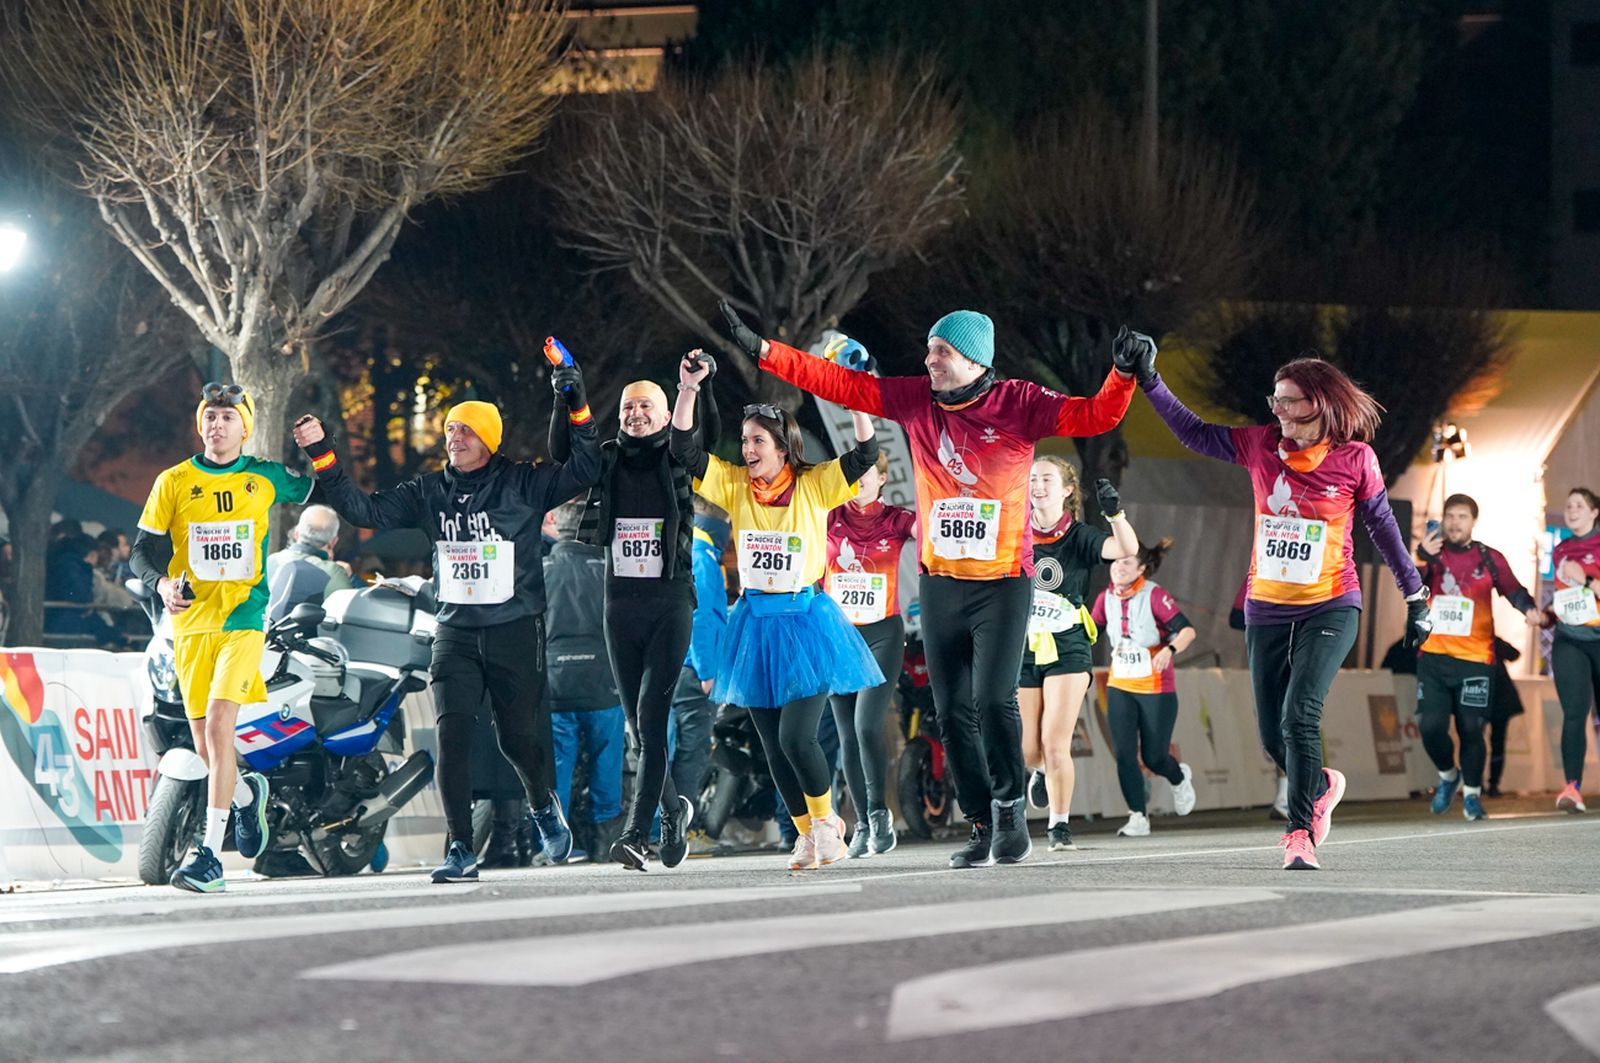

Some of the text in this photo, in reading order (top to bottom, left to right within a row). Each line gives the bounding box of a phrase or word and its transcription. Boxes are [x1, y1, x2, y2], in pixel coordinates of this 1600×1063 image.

[947, 459, 962, 475] 43
[213, 491, 233, 513] 10
[941, 520, 986, 540] 5868
[1265, 530, 1277, 538] SAN
[754, 535, 773, 543] NOCHE
[202, 543, 242, 560] 1866
[622, 540, 661, 557] 6873
[1266, 539, 1311, 561] 5869
[752, 551, 792, 571] 2361
[451, 562, 489, 579] 2361
[841, 590, 875, 606] 2876
[1439, 610, 1463, 622] 1904
[74, 708, 138, 761] SAN
[35, 733, 79, 818] 43
[95, 769, 158, 822] ANT
